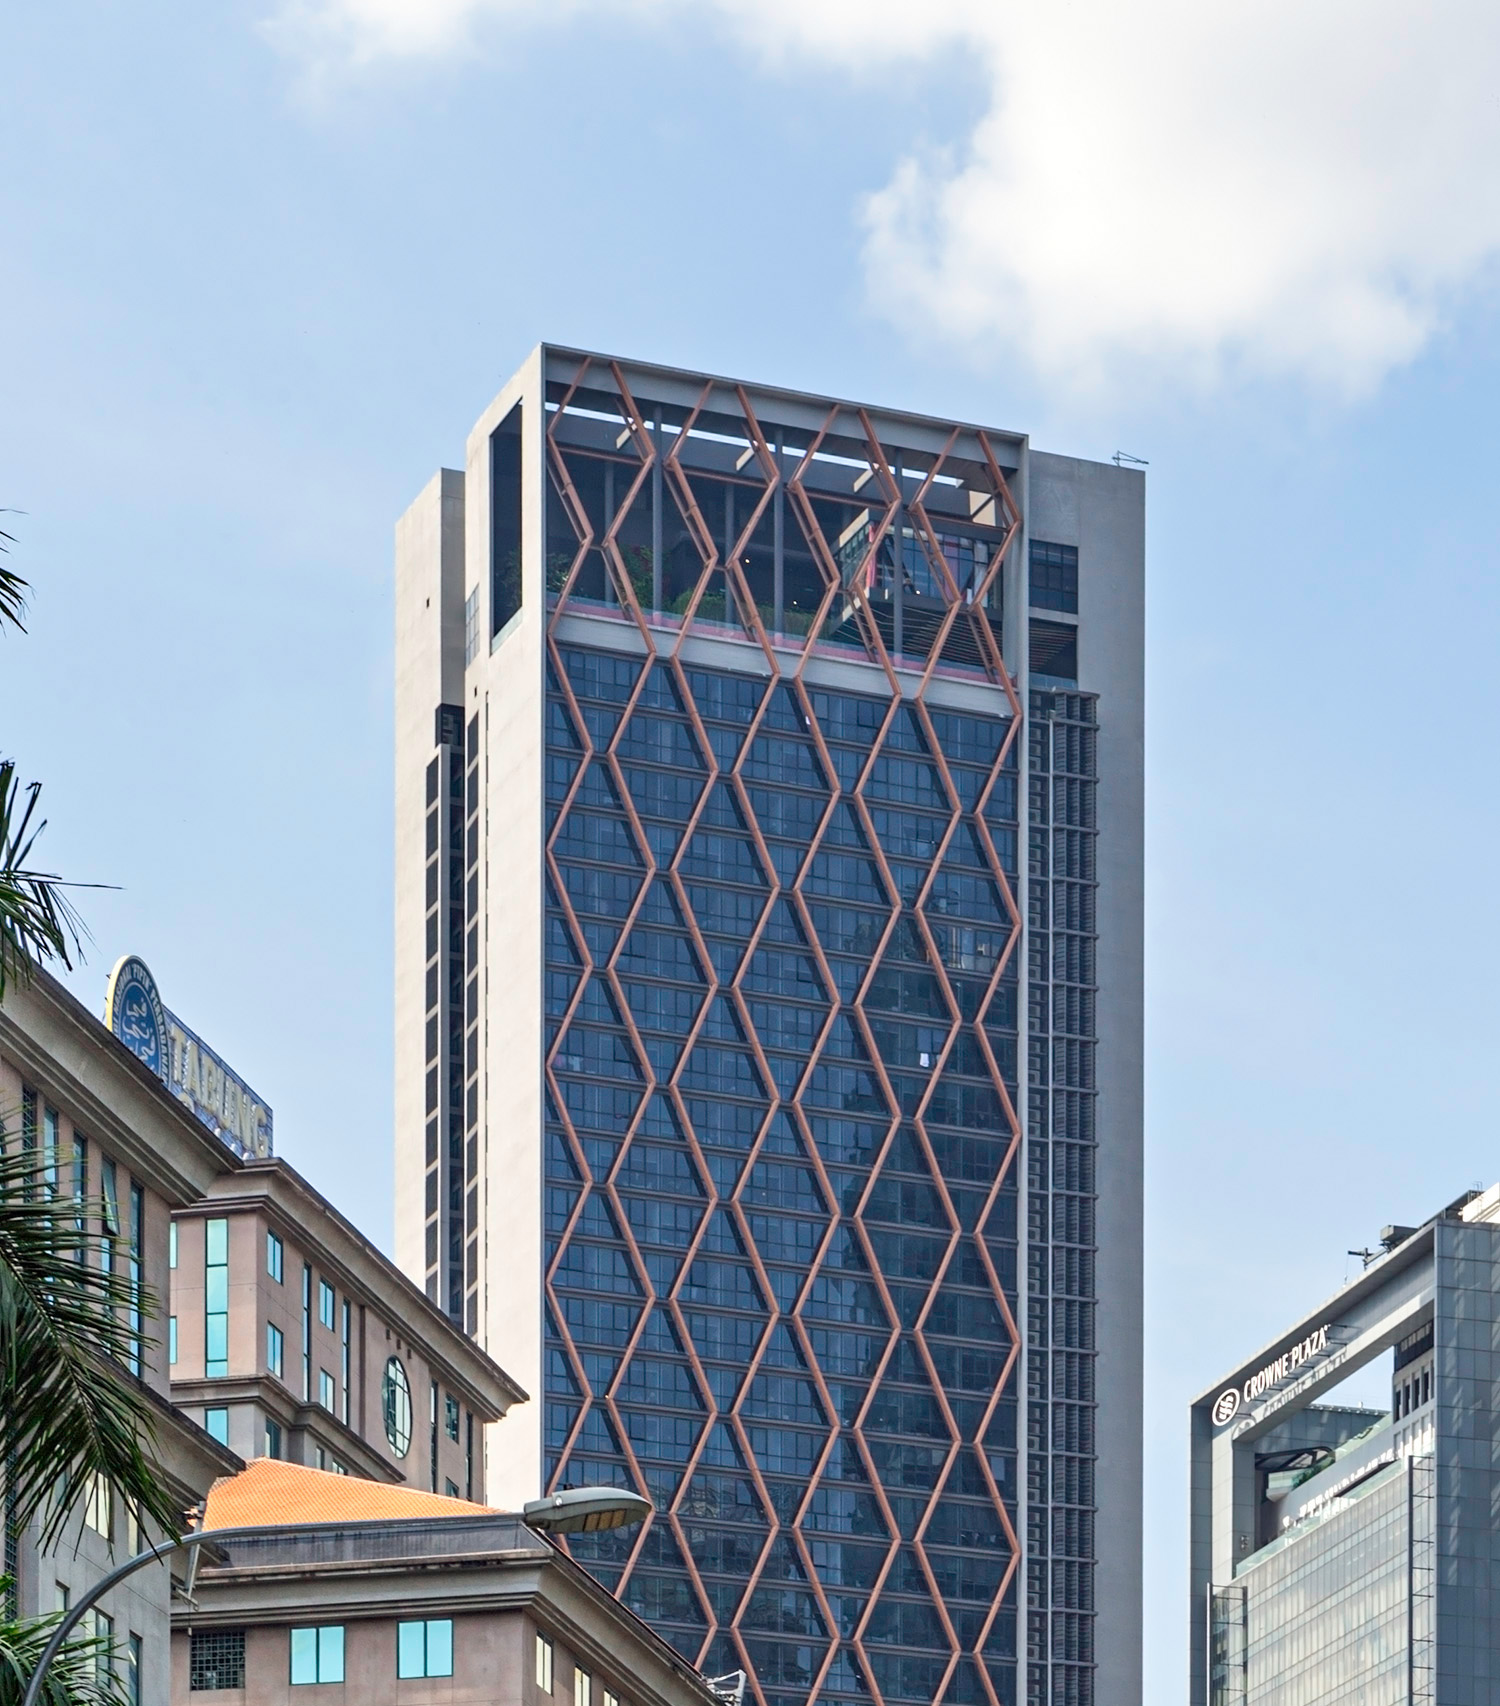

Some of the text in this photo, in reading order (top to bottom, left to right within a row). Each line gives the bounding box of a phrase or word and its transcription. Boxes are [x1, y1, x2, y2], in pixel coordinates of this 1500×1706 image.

[170, 1022, 269, 1158] TABUNG
[1243, 1327, 1327, 1403] CROWNE PLAZA
